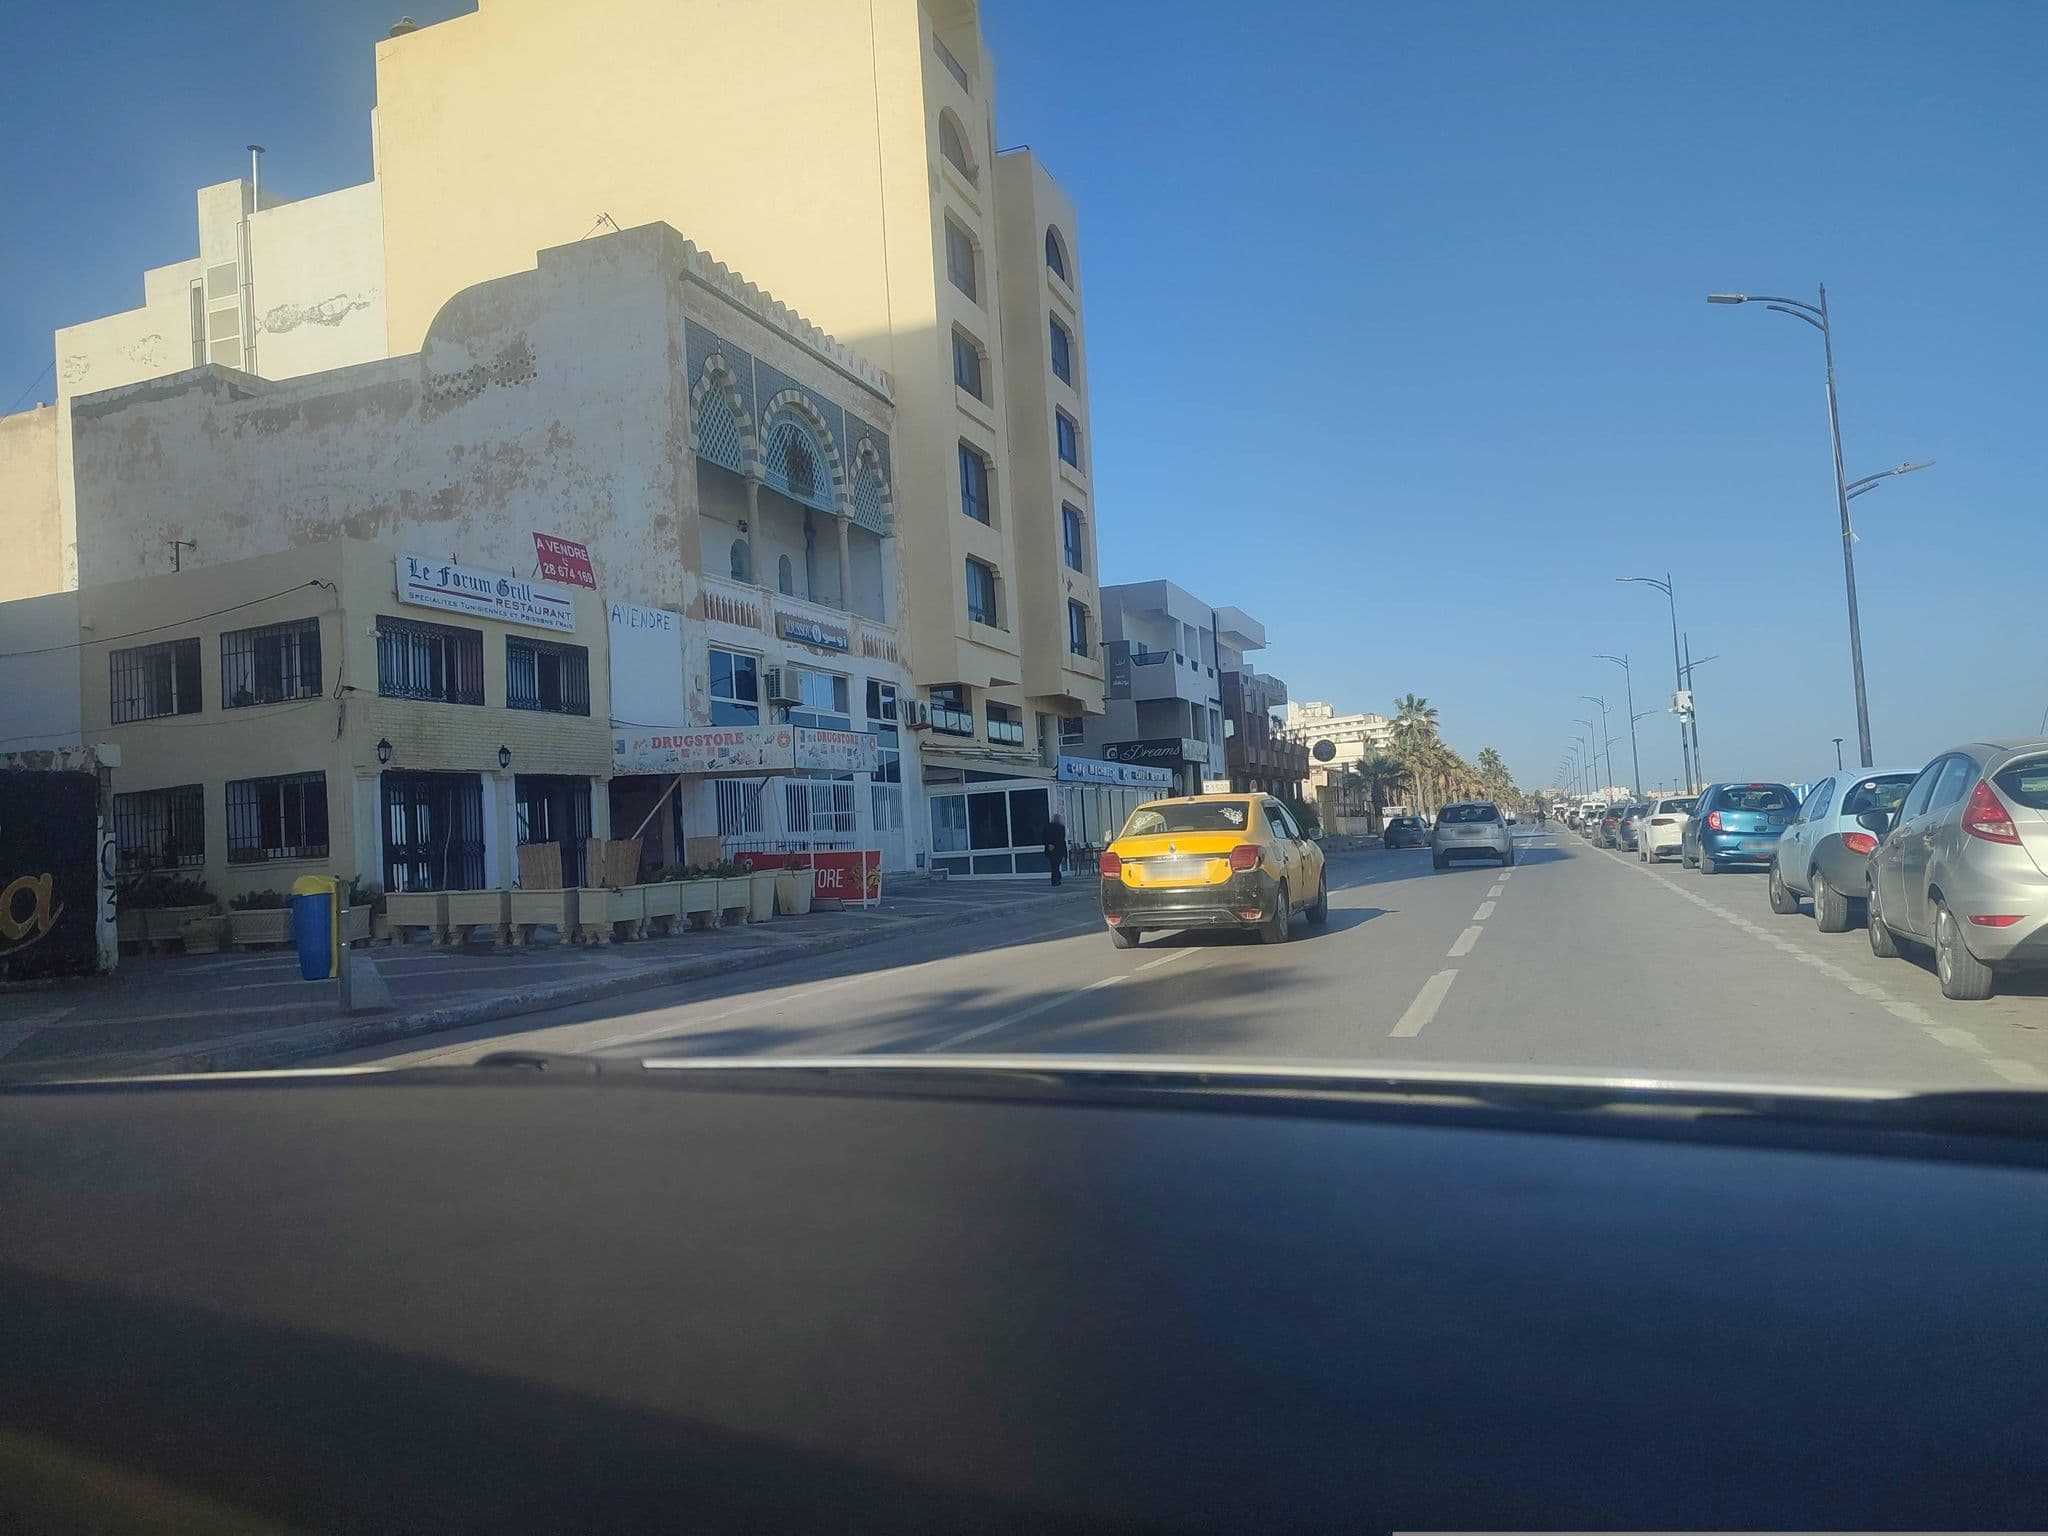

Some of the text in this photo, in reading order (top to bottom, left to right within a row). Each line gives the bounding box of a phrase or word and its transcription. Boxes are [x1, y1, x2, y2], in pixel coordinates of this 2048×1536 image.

[537, 537, 588, 561] A VENDRE
[406, 556, 531, 602] Le Forum Grill
[543, 562, 556, 576] 28
[557, 565, 576, 579] 674
[496, 597, 572, 620] RESTAURANT
[611, 604, 671, 630] A VENDRE
[651, 732, 745, 749] DRUGSTORE
[816, 731, 859, 745] DRUGSTORE
[1120, 744, 1180, 761] Dreams
